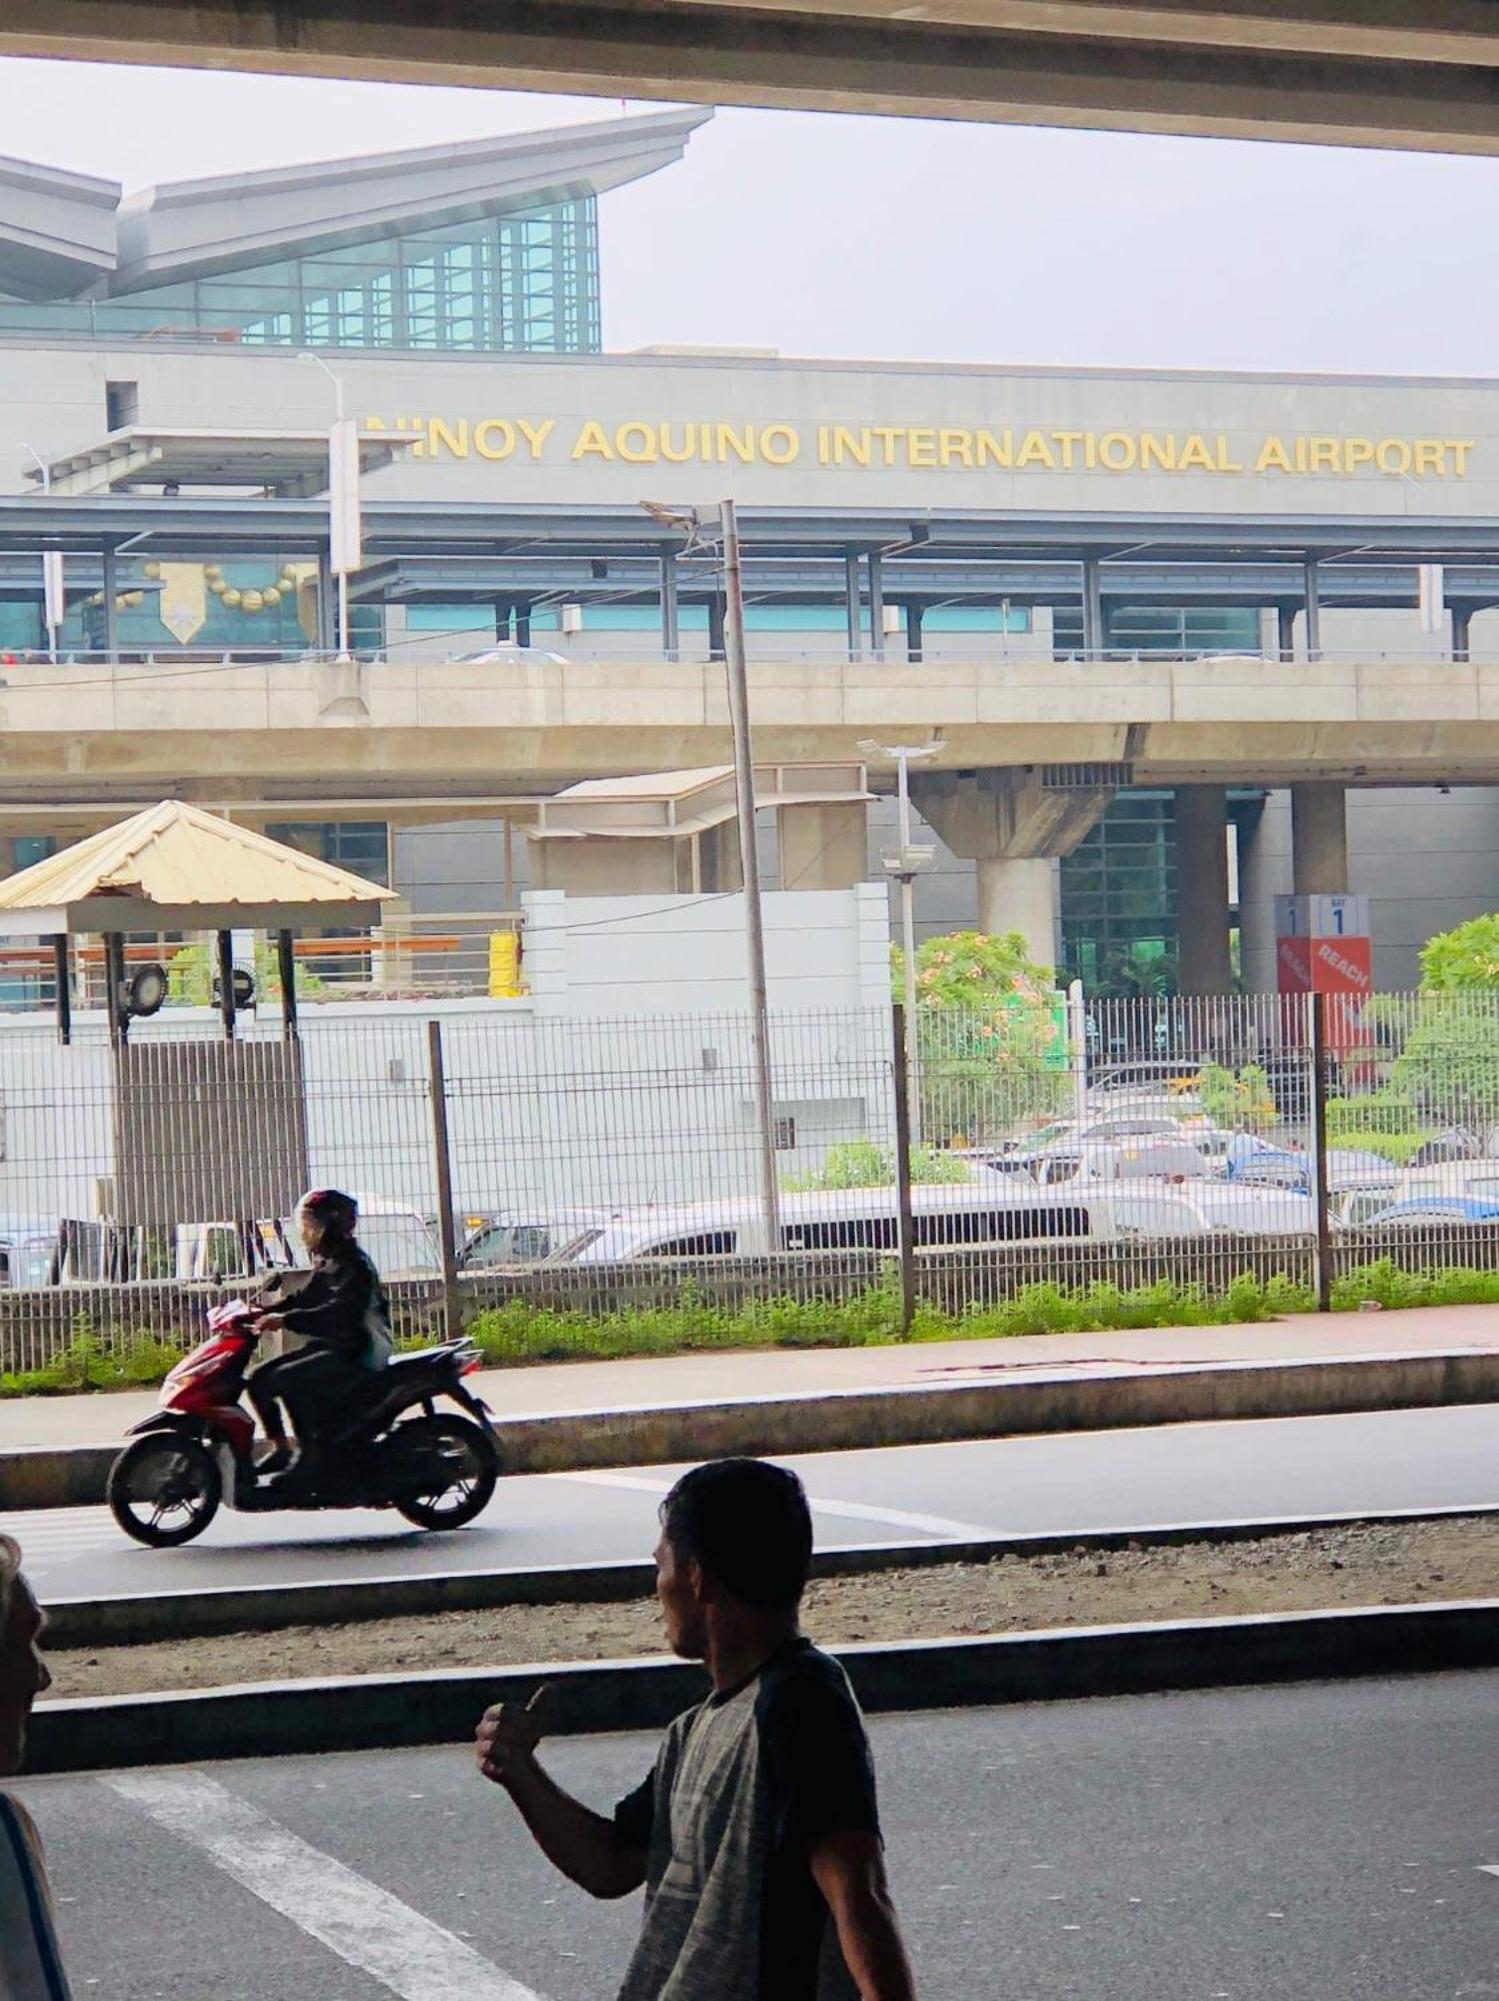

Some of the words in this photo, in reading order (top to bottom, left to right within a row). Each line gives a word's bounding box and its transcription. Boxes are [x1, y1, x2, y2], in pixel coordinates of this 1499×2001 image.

[571, 421, 800, 464] AQUINO
[818, 426, 1242, 473] INTERNATIONAL
[1255, 436, 1475, 476] AIRPORT
[1333, 909, 1343, 934] 1
[1318, 943, 1368, 987] REACH
